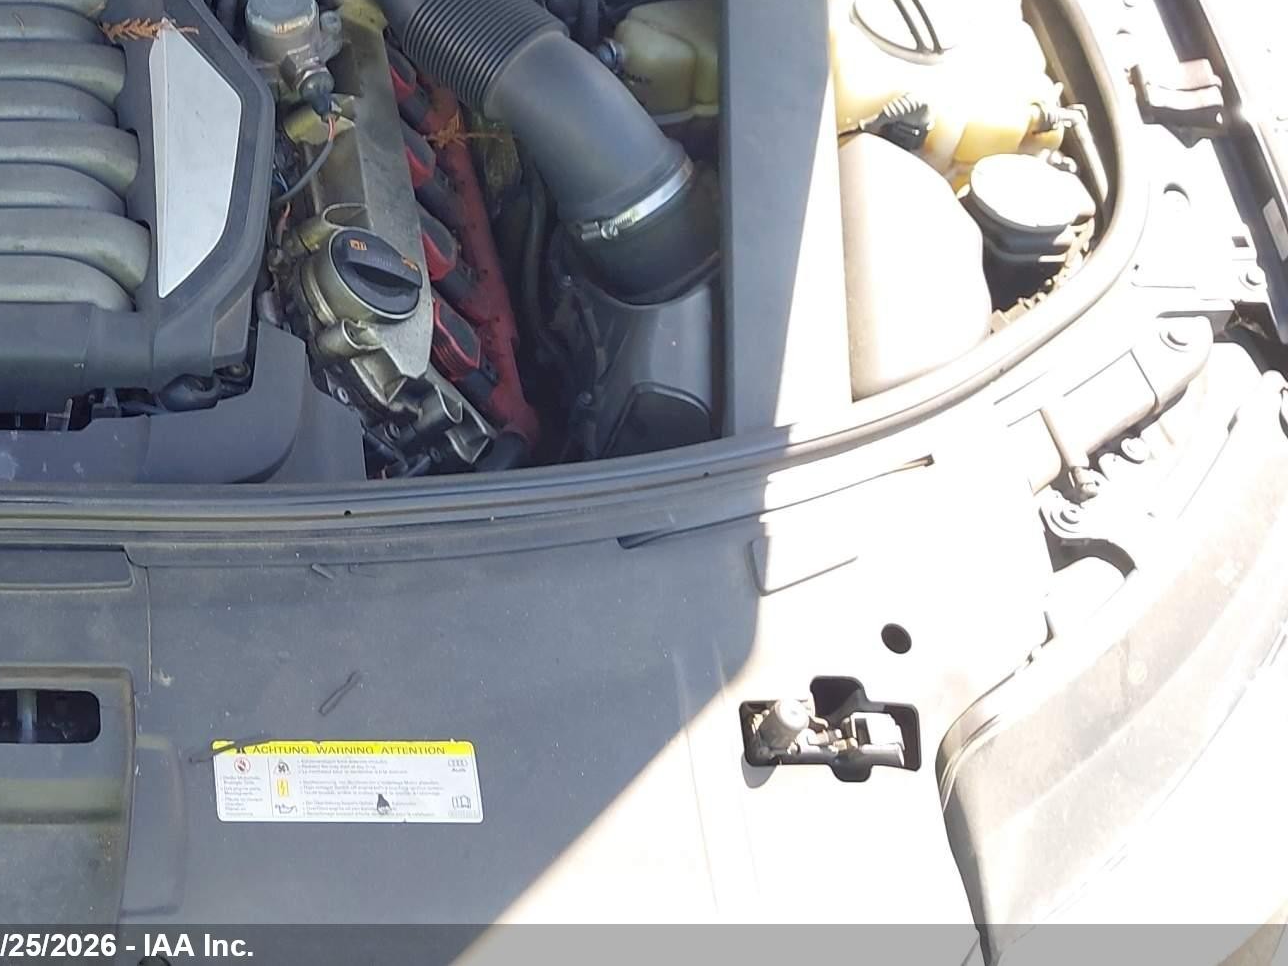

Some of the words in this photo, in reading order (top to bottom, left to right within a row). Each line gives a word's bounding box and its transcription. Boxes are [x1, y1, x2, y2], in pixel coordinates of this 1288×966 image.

[252, 745, 309, 755] ACHTUNG
[315, 745, 374, 755] WARNING
[381, 745, 446, 755] ATTENTION
